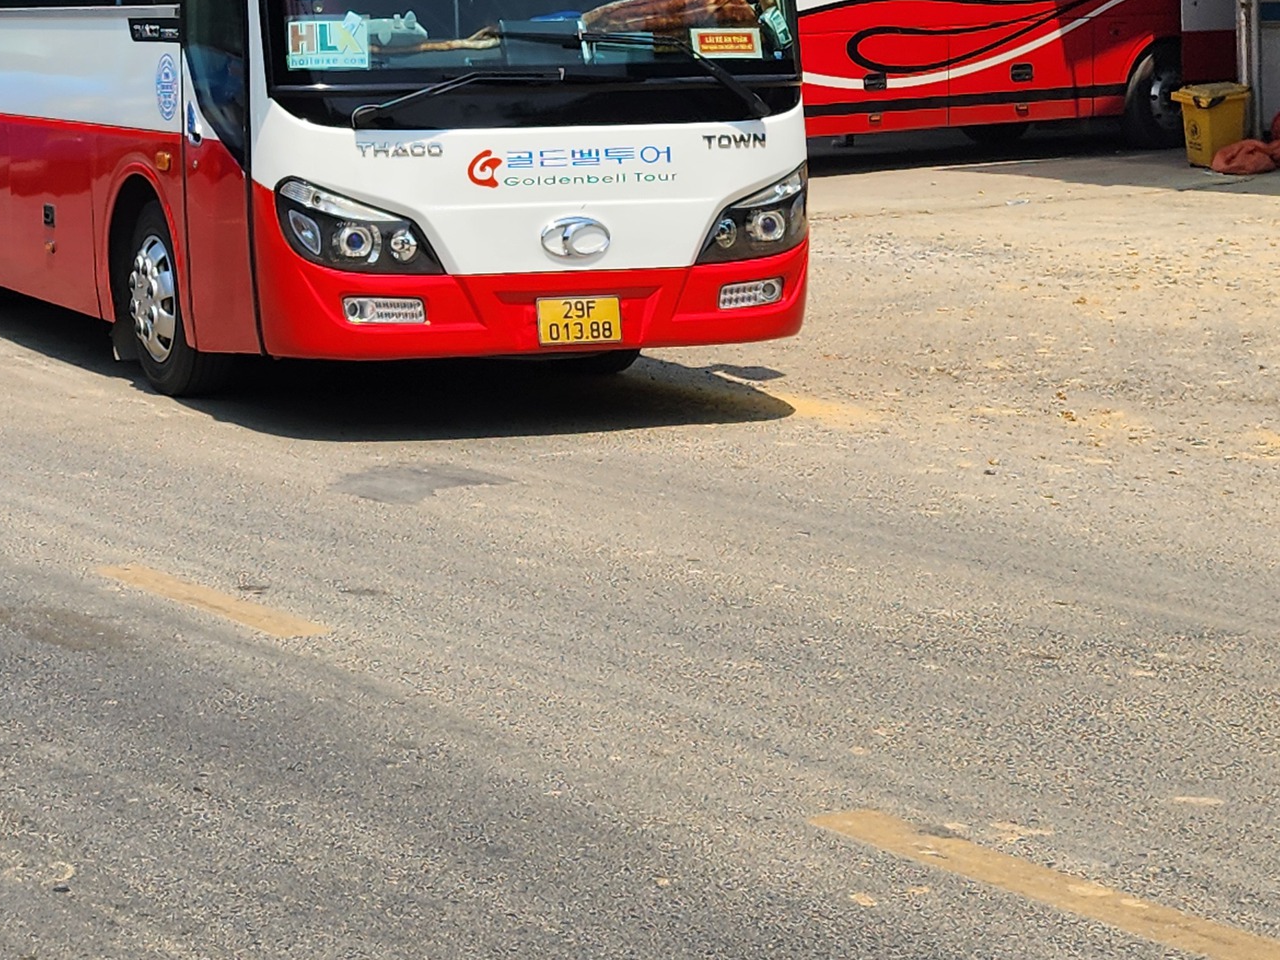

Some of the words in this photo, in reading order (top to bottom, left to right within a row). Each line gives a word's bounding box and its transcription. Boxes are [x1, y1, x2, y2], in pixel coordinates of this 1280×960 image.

[290, 23, 365, 54] HLX
[356, 141, 444, 159] THACO
[702, 132, 767, 150] TOWN
[505, 145, 672, 170] 골든벨투어
[503, 173, 627, 188] Goldenbell
[634, 171, 678, 184] Tour
[561, 300, 596, 319] 29F
[549, 321, 613, 341] 013.88
